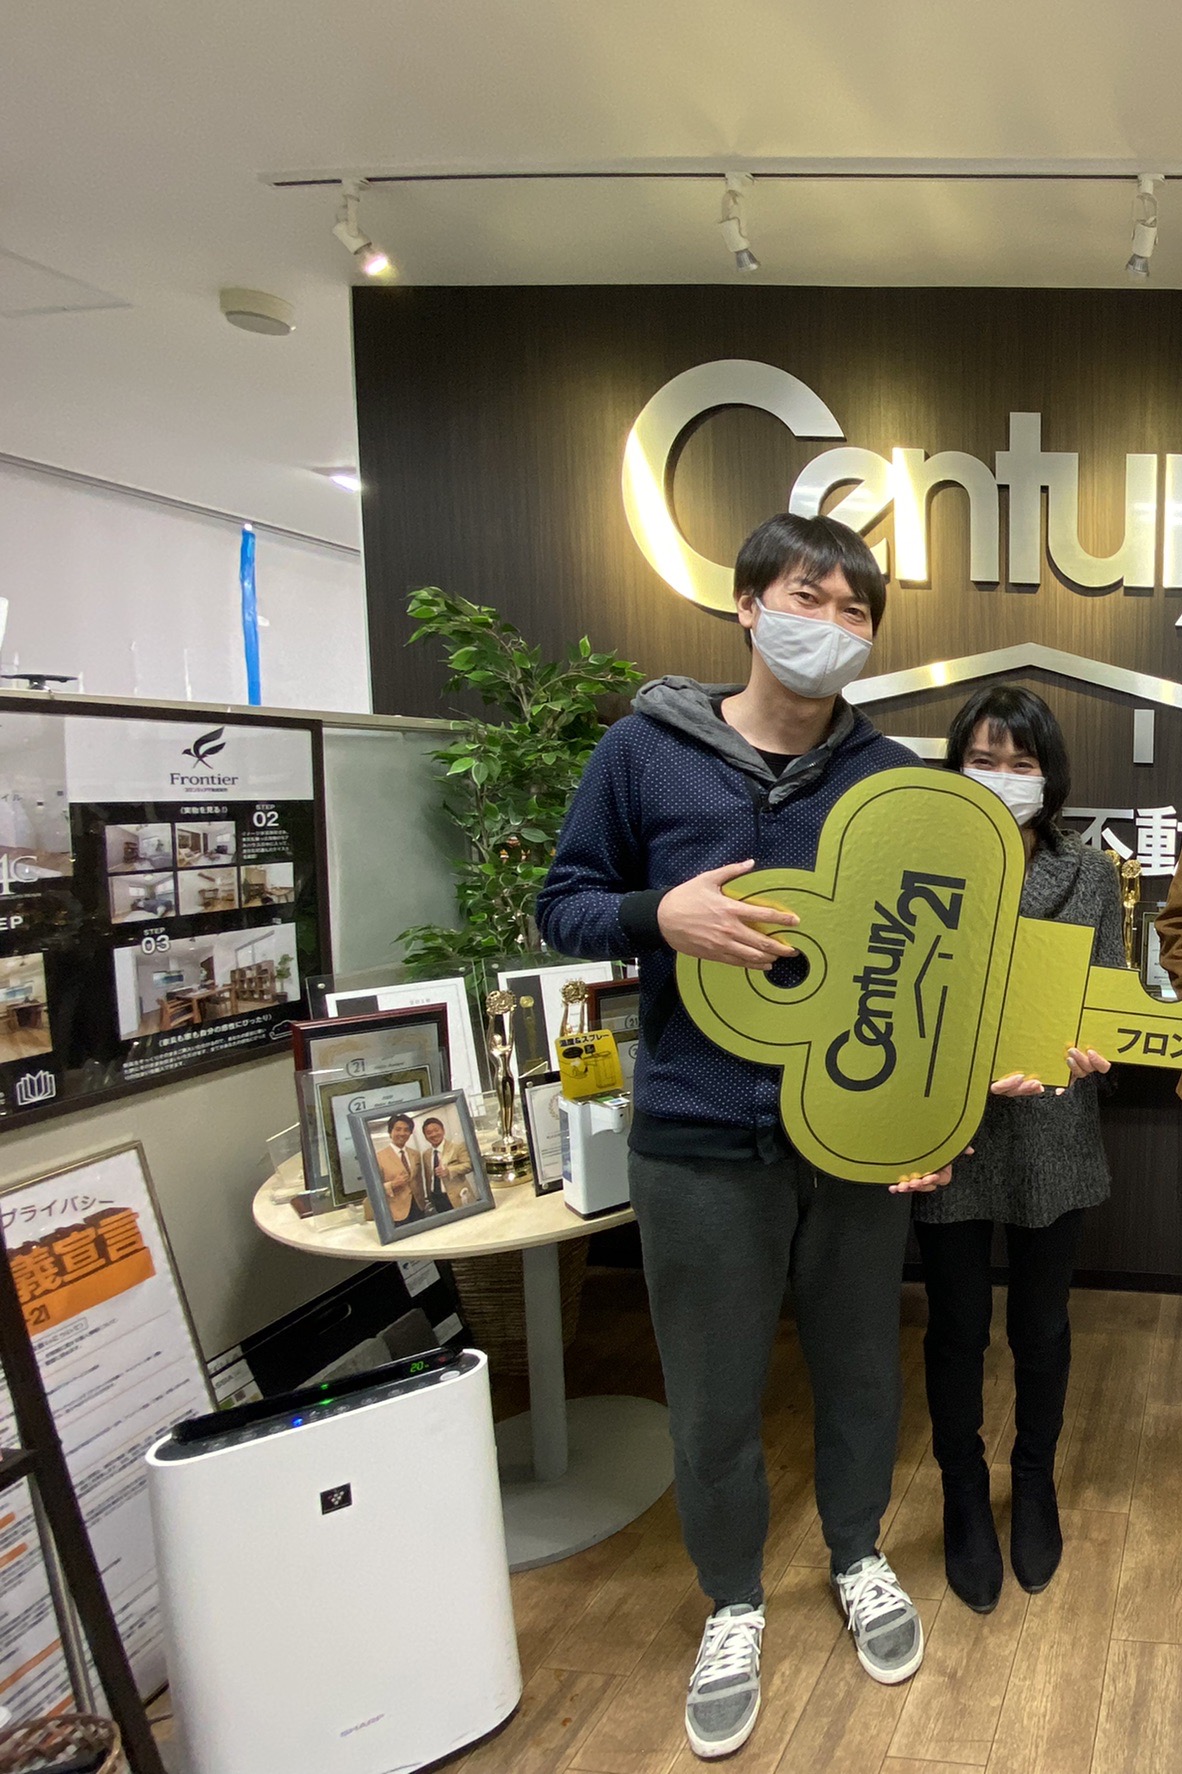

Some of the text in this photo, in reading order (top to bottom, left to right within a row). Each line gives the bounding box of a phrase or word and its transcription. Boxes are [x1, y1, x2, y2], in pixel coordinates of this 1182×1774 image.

[170, 773, 239, 785] Frontier
[253, 811, 279, 827] 02
[143, 927, 166, 935] STEP
[141, 934, 170, 954] 03
[825, 870, 966, 1091] Century 21
[340, 1713, 385, 1737] SHARP
